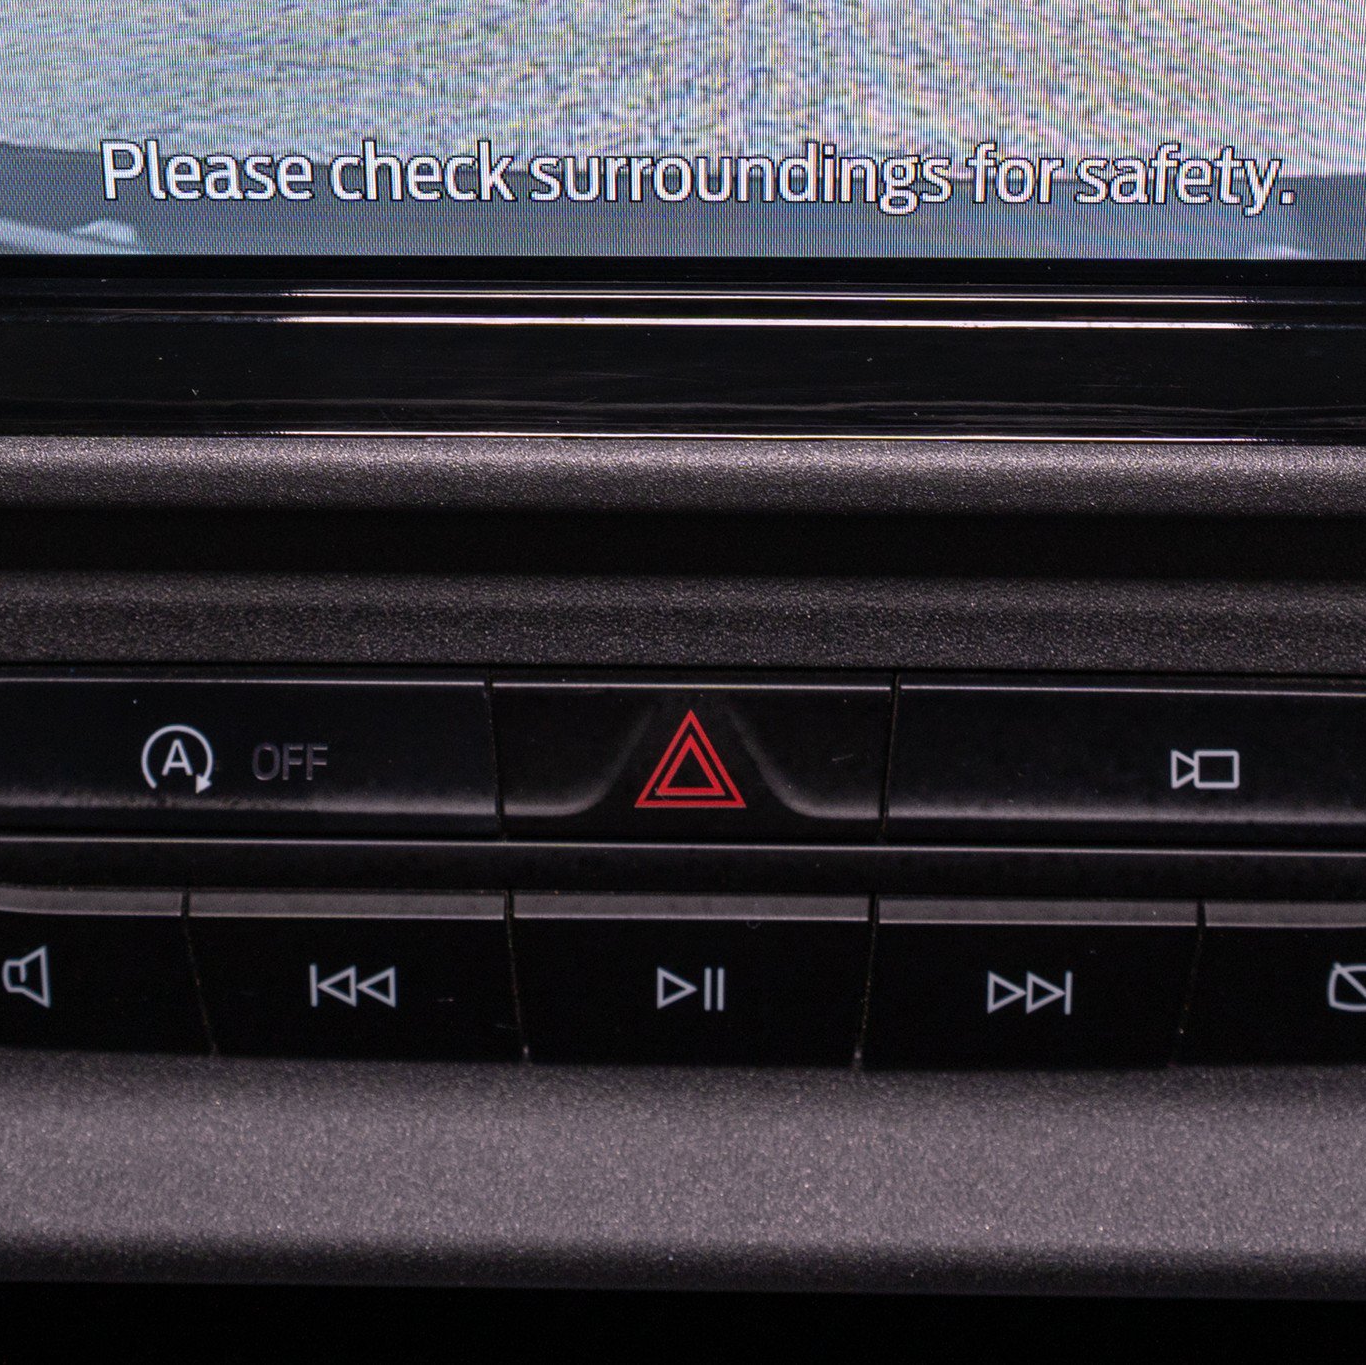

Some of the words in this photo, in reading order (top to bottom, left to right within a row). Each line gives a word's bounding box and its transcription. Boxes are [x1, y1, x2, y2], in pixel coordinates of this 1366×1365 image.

[99, 139, 313, 202] Please
[331, 139, 517, 203] check
[529, 140, 953, 215] surroundings
[968, 141, 1064, 204] for
[1075, 141, 1295, 217] safety.
[251, 742, 329, 781] OFF
